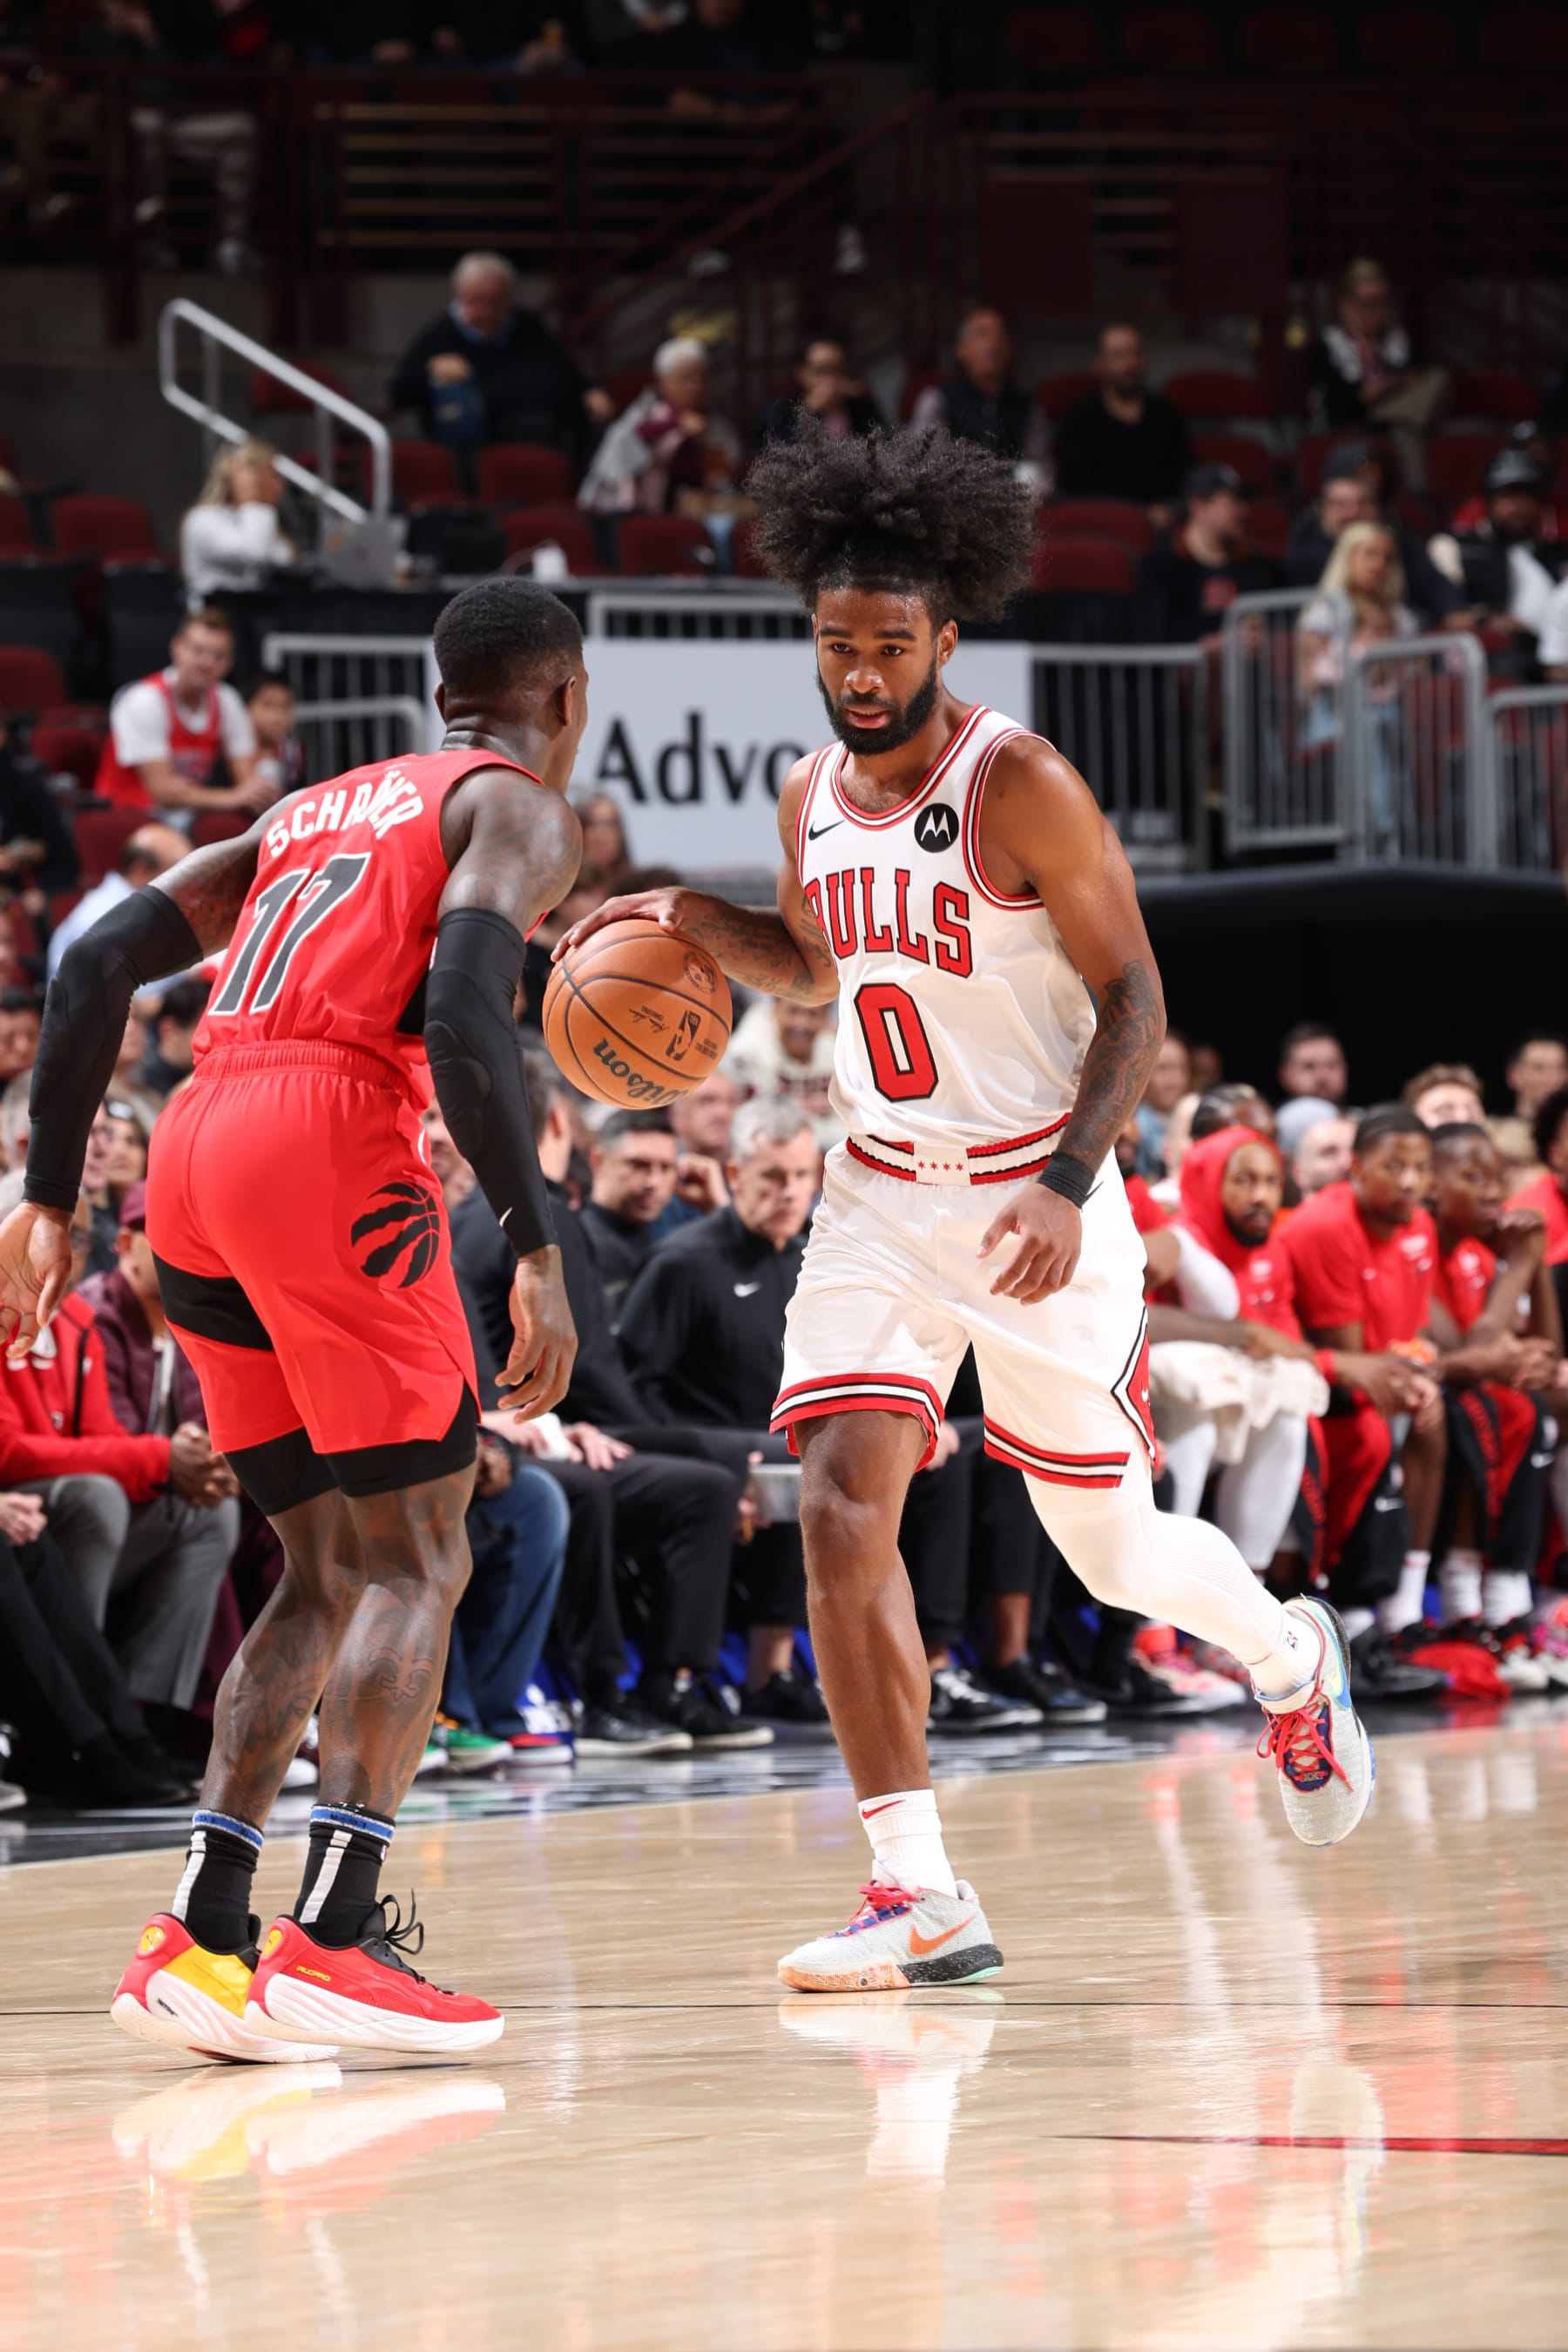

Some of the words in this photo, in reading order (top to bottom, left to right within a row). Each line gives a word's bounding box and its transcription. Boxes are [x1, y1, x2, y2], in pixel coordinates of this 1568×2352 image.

[266, 769, 424, 858] SCHRÖER
[206, 851, 372, 1016] 17
[854, 983, 939, 1103] 0
